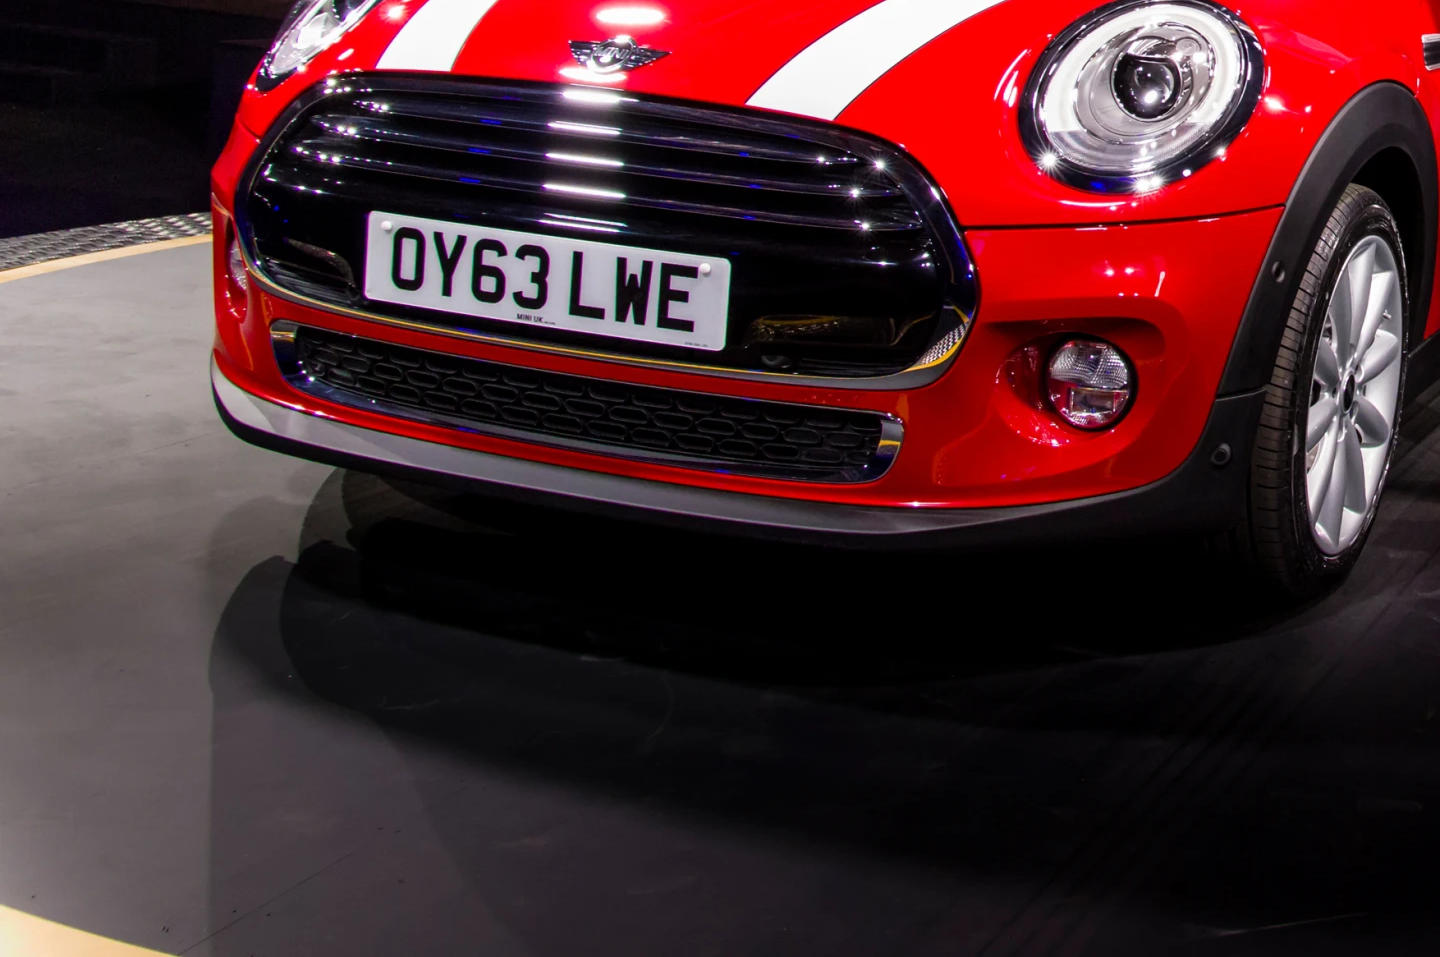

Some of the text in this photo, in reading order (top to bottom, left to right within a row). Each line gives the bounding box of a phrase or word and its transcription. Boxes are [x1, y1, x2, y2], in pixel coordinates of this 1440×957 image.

[391, 226, 699, 333] OY63 LWE
[516, 312, 533, 322] MINI
[533, 315, 544, 324] UK
